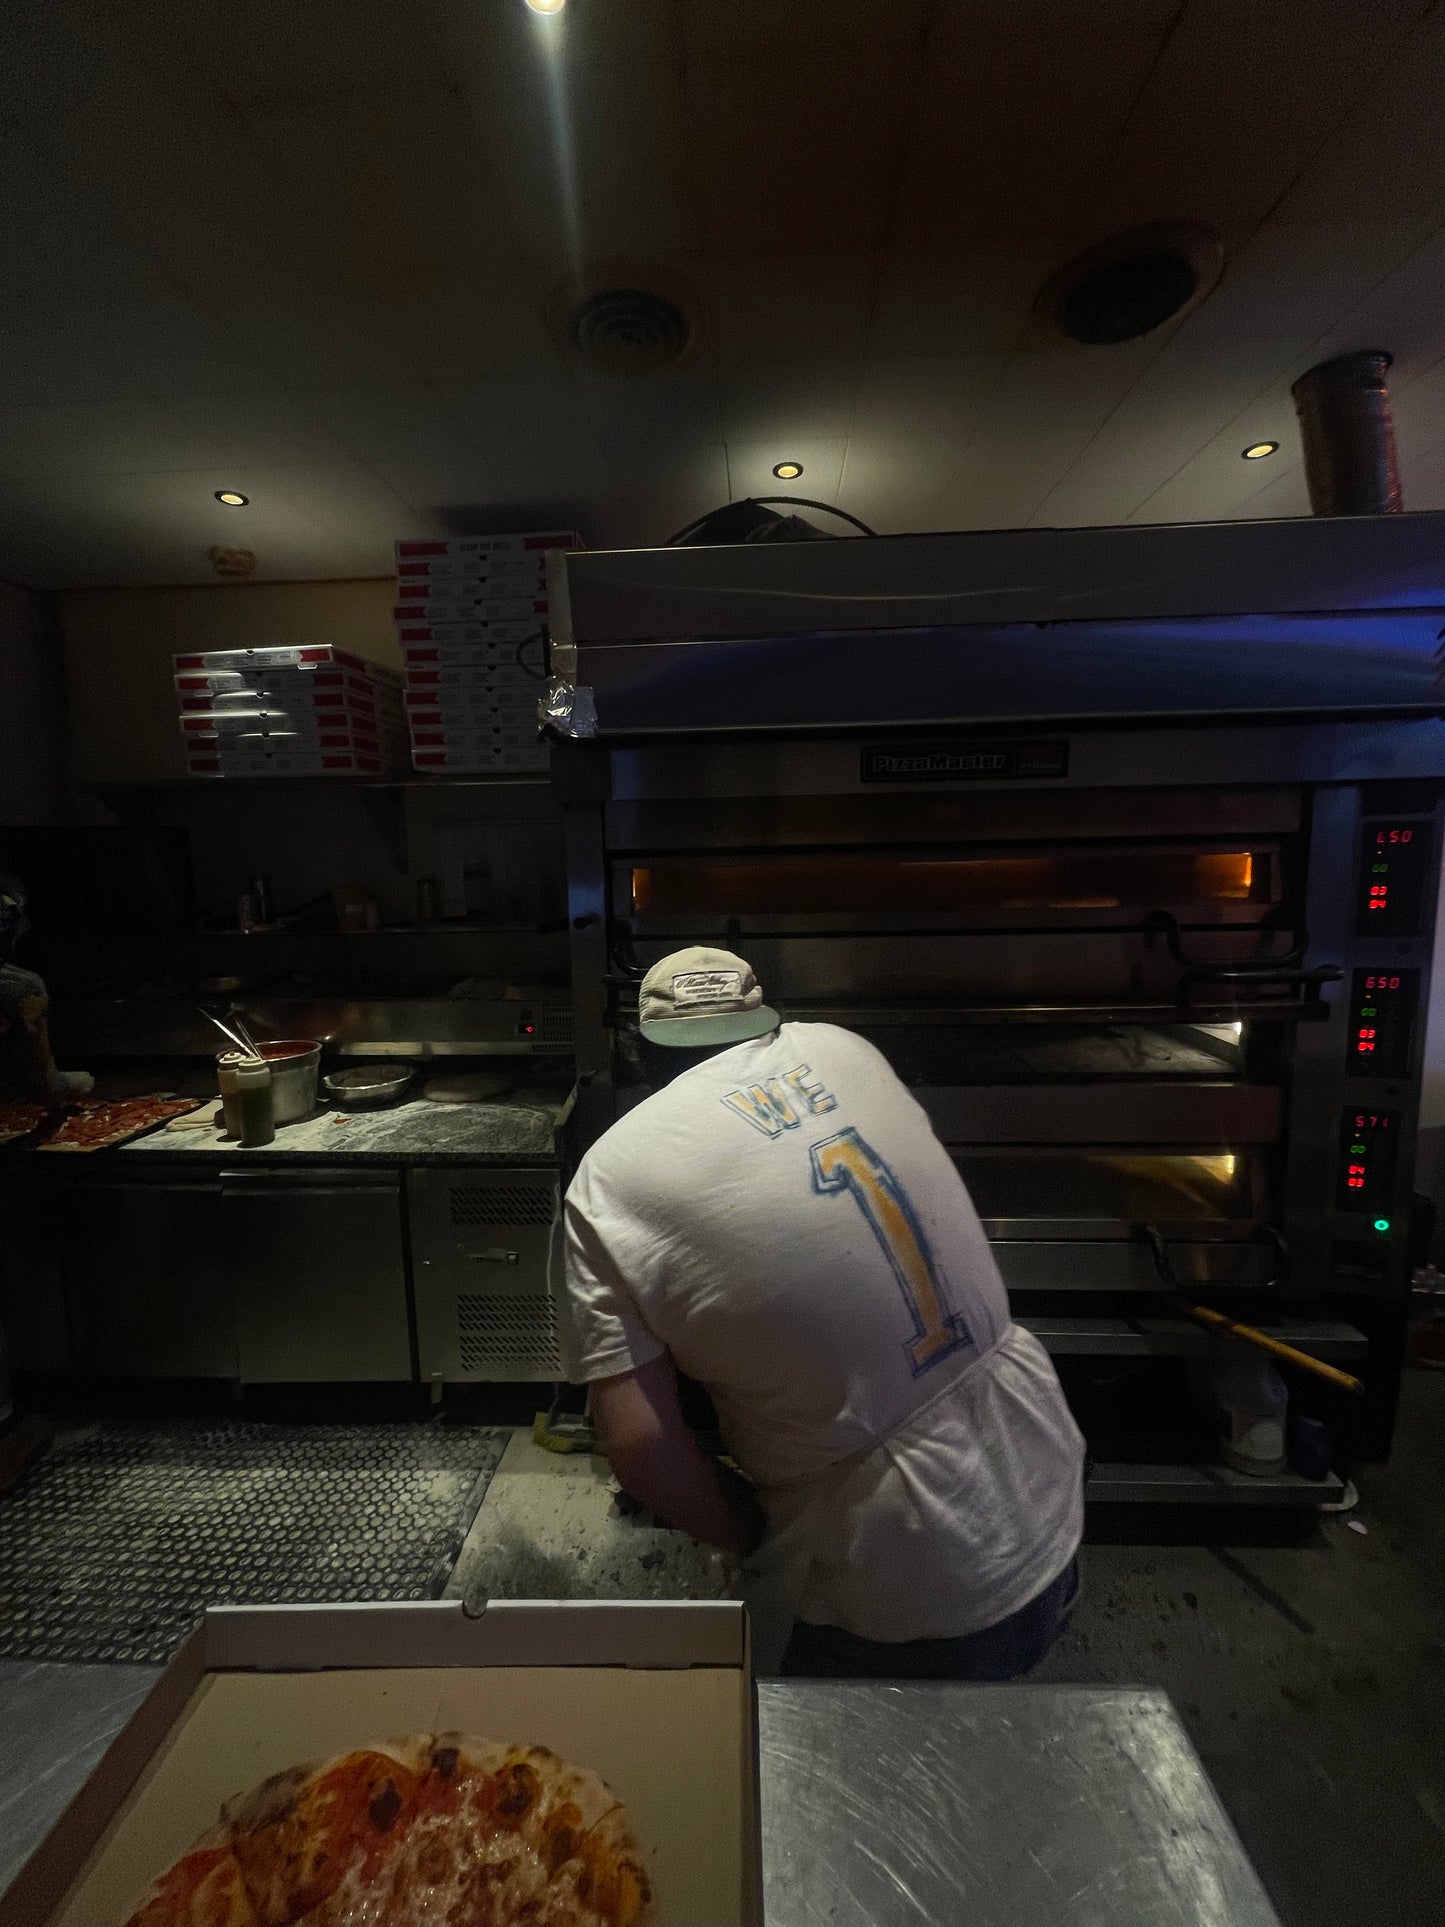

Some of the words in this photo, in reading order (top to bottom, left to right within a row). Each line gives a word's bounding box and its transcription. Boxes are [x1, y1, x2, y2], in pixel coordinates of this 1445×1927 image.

[1365, 976, 1400, 989] 650
[720, 1063, 838, 1139] WE
[1355, 1115, 1389, 1128] 571
[808, 1126, 975, 1379] 1
